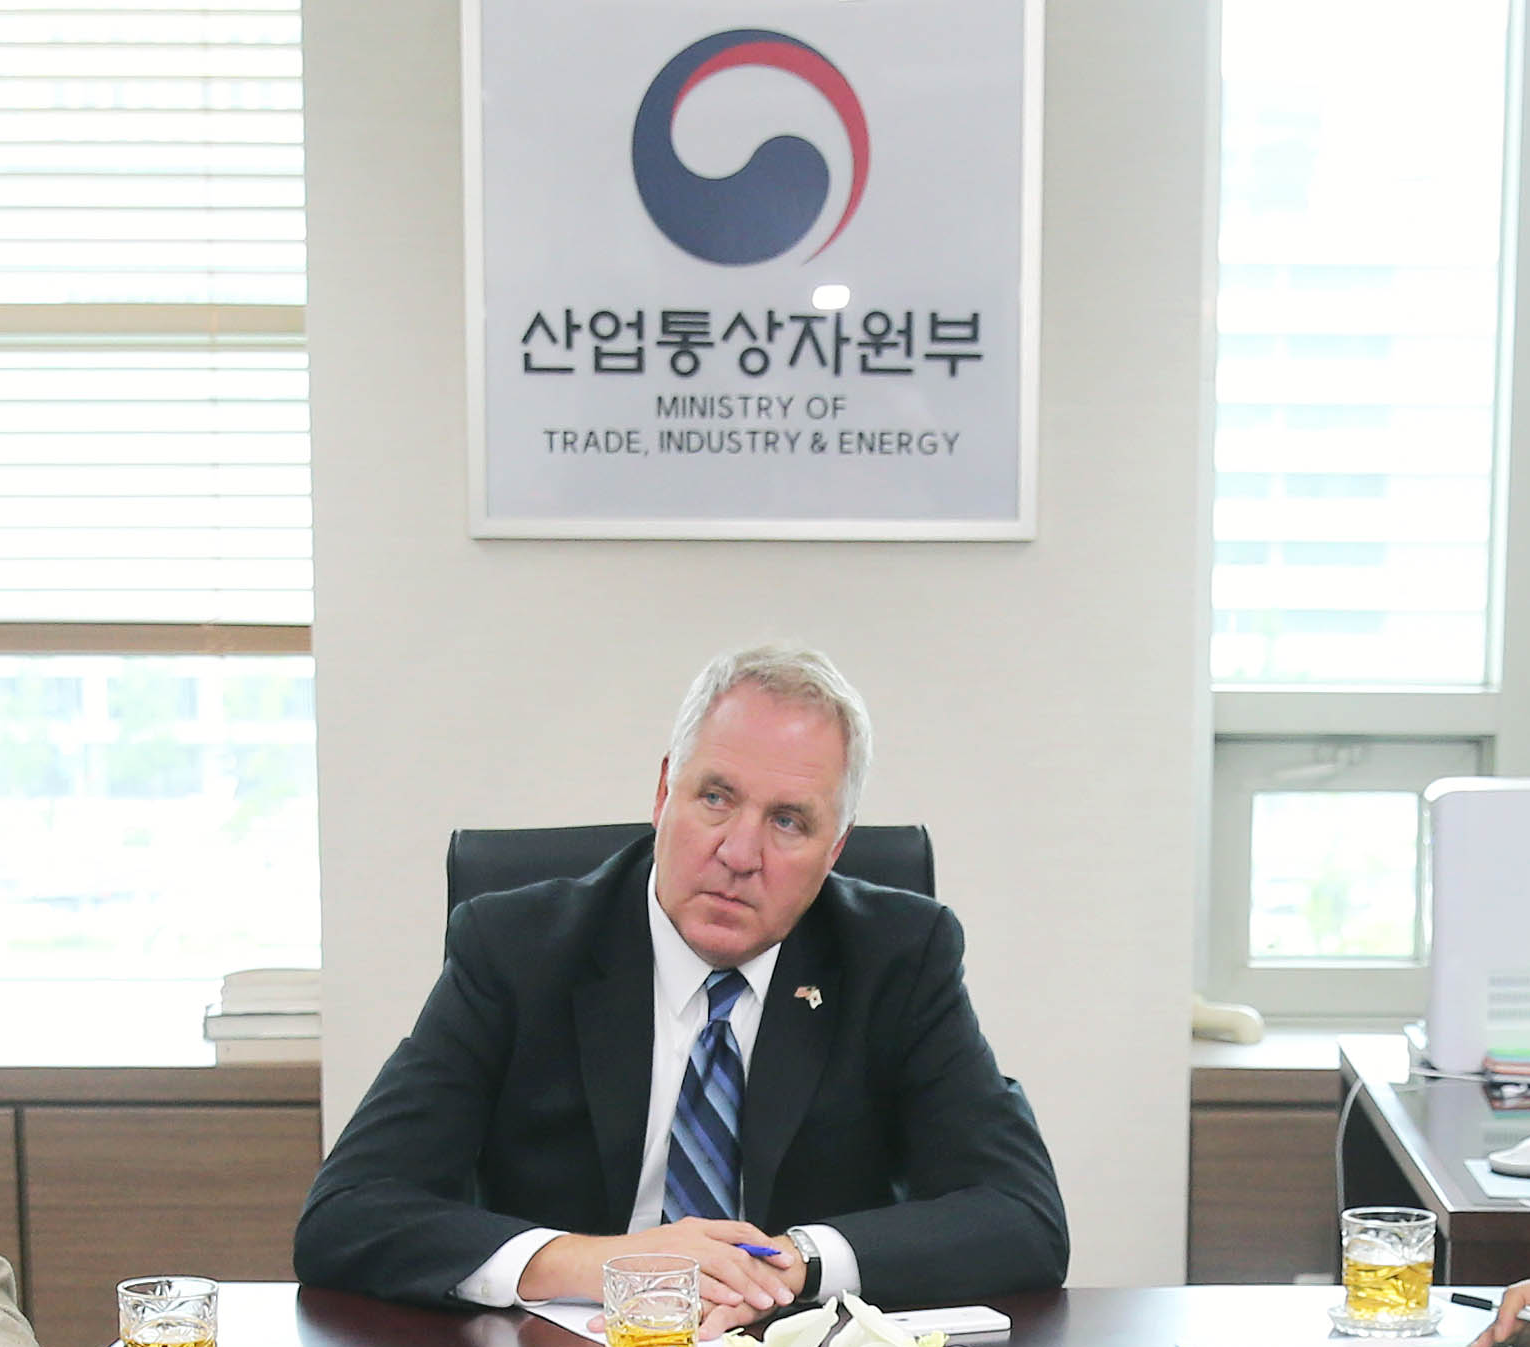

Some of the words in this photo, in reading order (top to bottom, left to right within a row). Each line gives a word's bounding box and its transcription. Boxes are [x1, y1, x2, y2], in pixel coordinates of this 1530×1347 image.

[521, 308, 984, 378] 산업통상자원부
[655, 393, 795, 420] MINISTRY
[804, 394, 847, 420] OF
[542, 429, 650, 457] TRADE,
[658, 429, 802, 455] INDUSTRY
[809, 430, 829, 455] &
[838, 429, 960, 456] ENERGY
